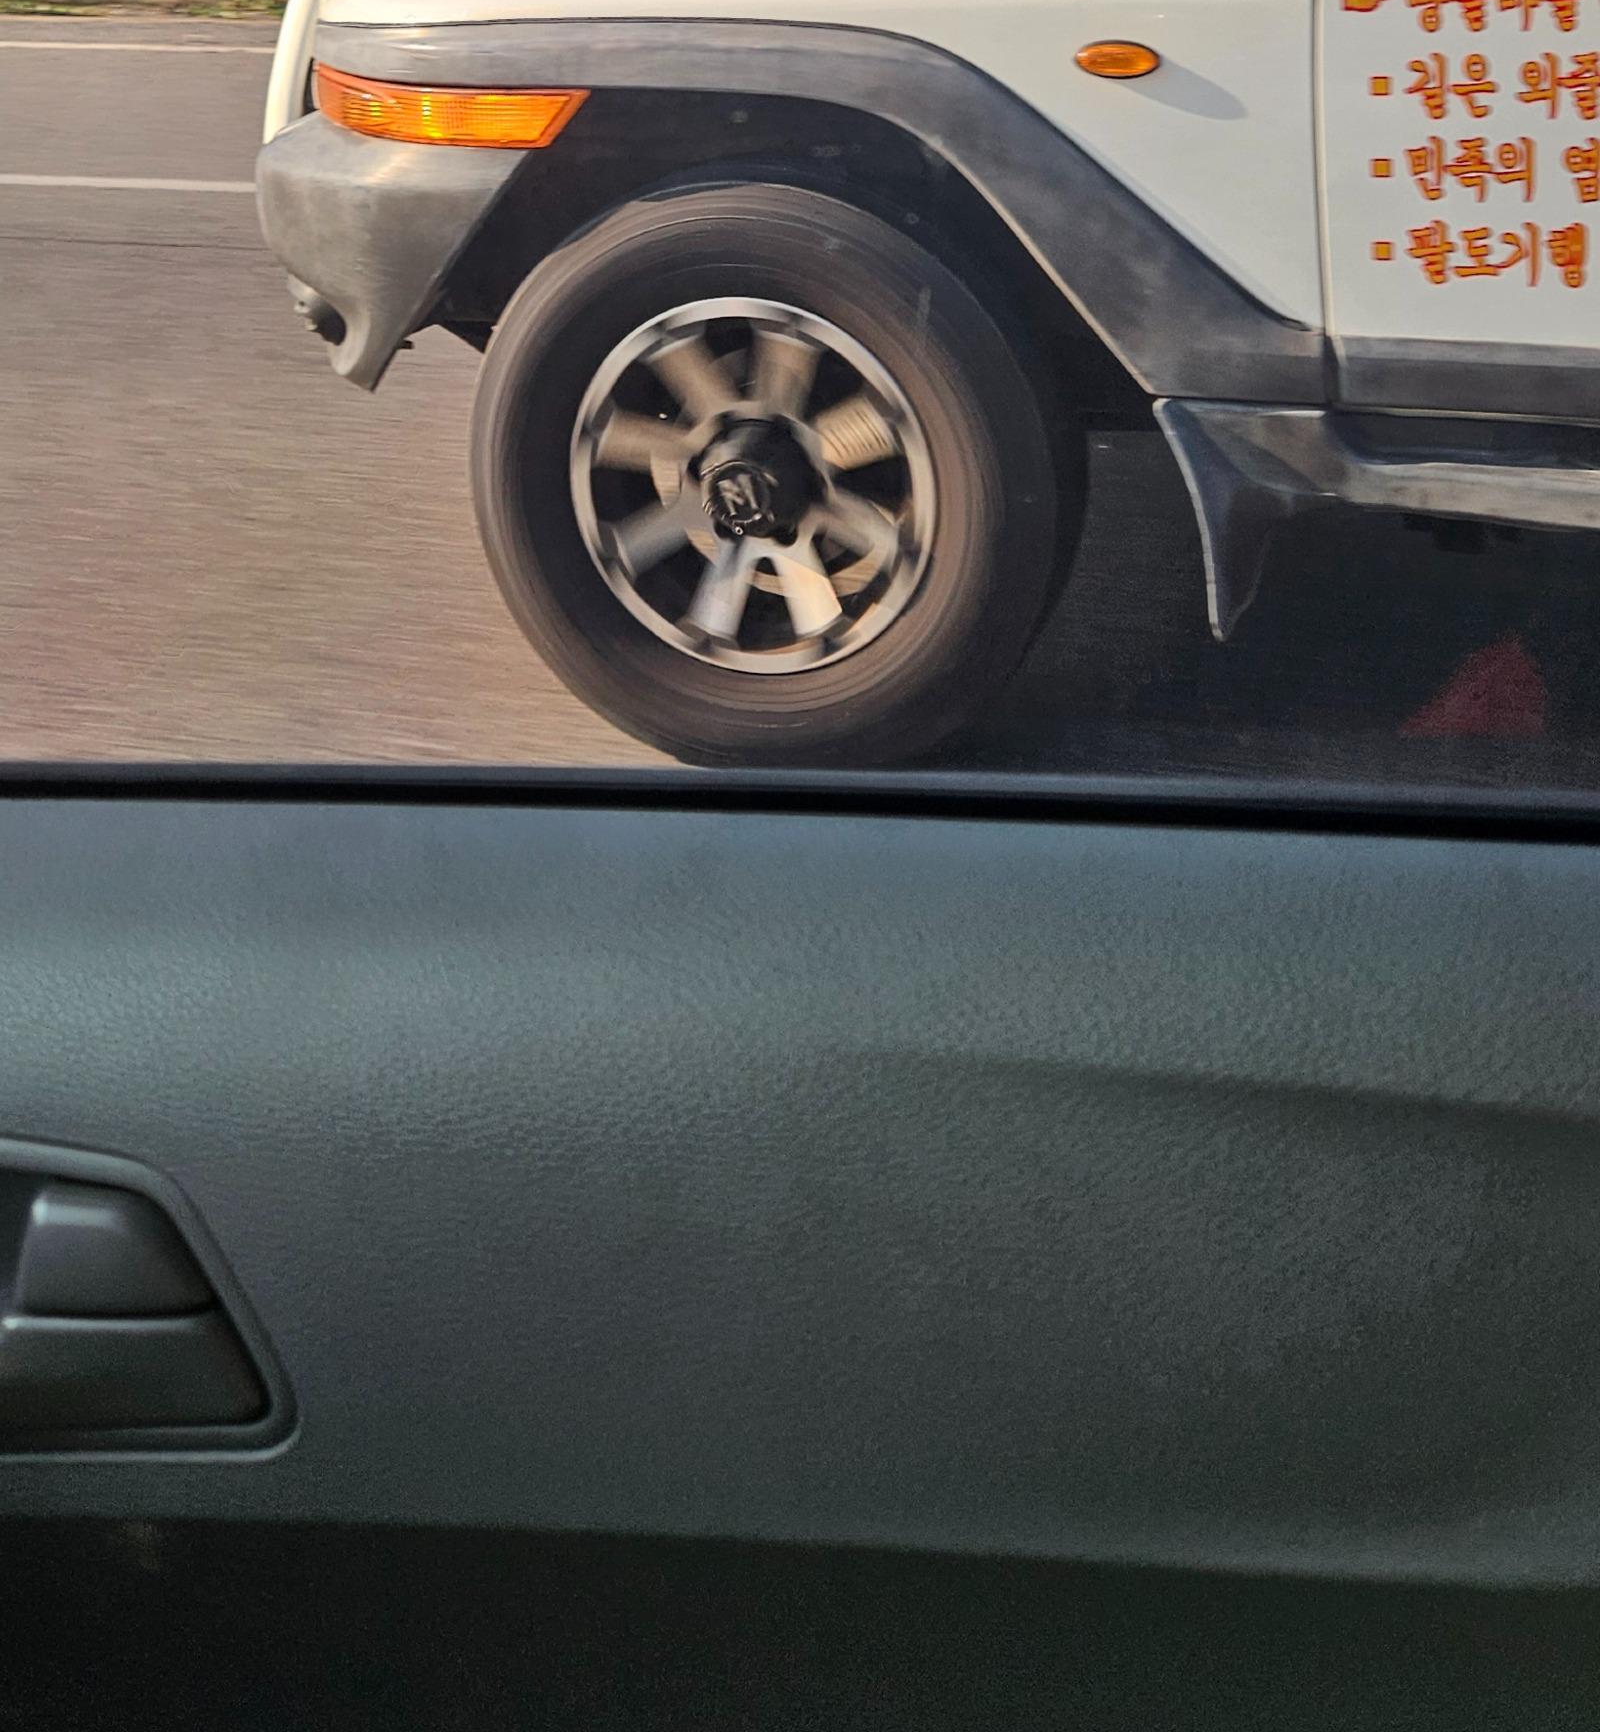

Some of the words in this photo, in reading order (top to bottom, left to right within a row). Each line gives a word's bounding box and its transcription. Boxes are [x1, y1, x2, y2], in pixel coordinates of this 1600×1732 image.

[1405, 52, 1497, 119] 길은
[1405, 135, 1535, 202] 민족의
[1405, 220, 1587, 288] 팔도기행
